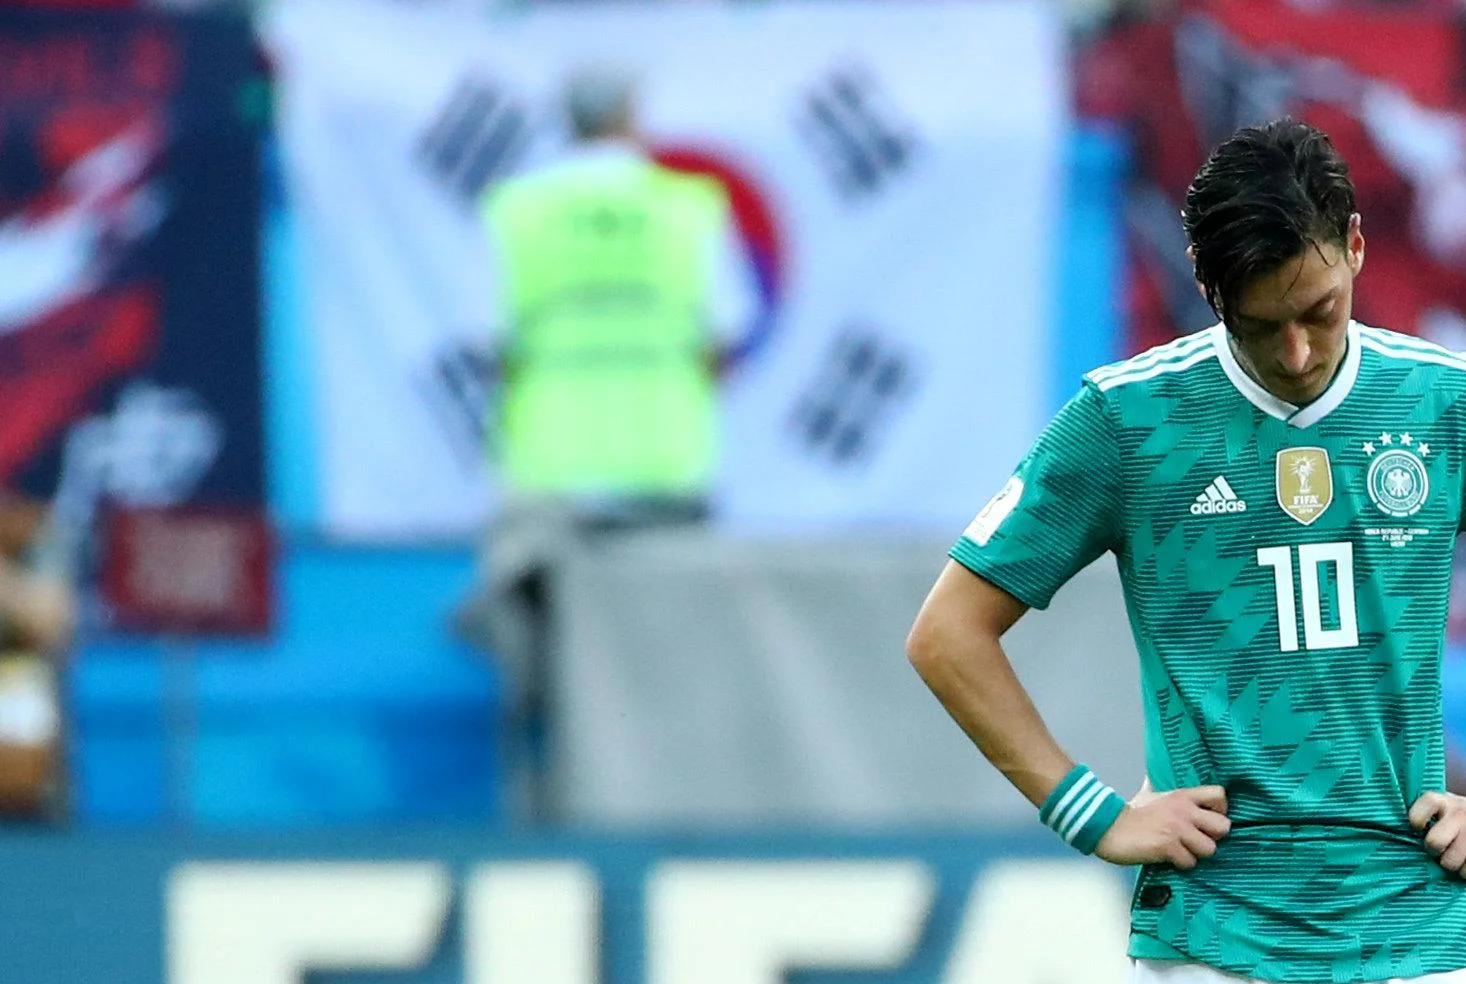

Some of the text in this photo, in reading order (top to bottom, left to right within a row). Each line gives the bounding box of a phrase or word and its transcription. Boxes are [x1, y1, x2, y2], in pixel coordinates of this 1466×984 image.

[1190, 500, 1247, 515] adidas
[1293, 495, 1319, 505] FIFA
[1257, 541, 1359, 652] 10
